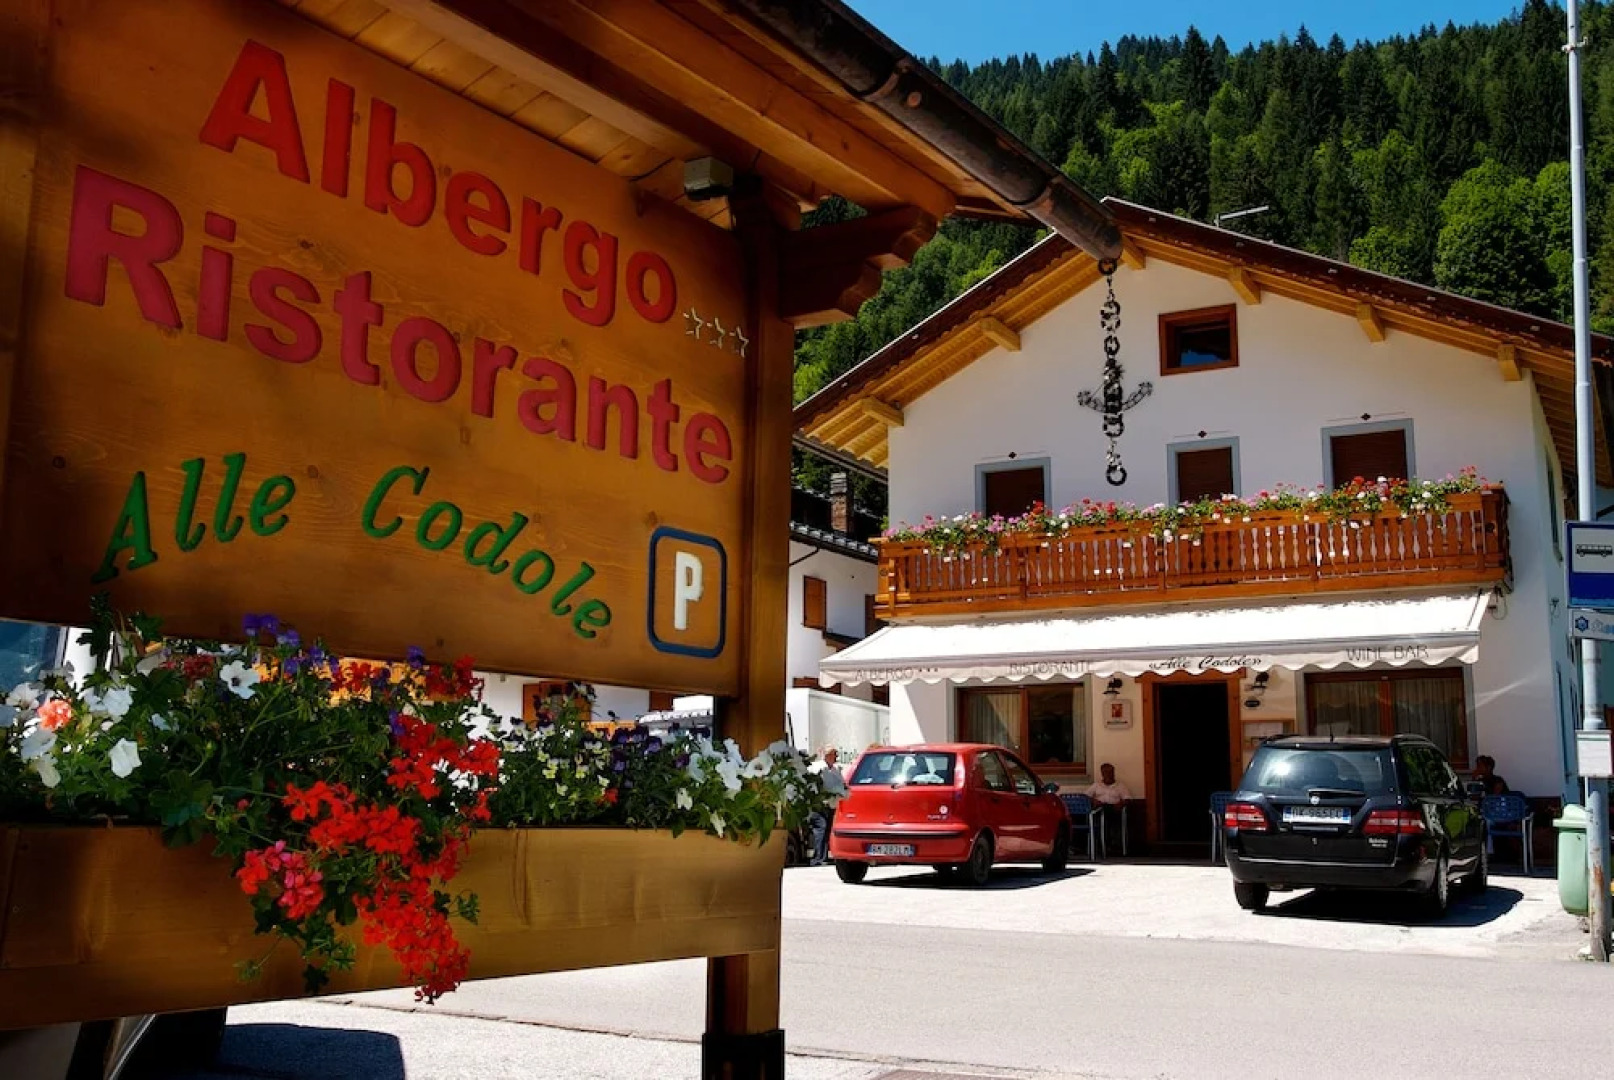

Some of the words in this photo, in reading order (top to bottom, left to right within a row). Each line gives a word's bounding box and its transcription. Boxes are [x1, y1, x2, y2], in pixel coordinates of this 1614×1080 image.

[200, 38, 678, 327] Albergo
[65, 164, 732, 484] Ristorante
[92, 453, 295, 584] Alle
[361, 466, 611, 639] Codole
[674, 552, 703, 630] P
[1394, 645, 1429, 660] BAR
